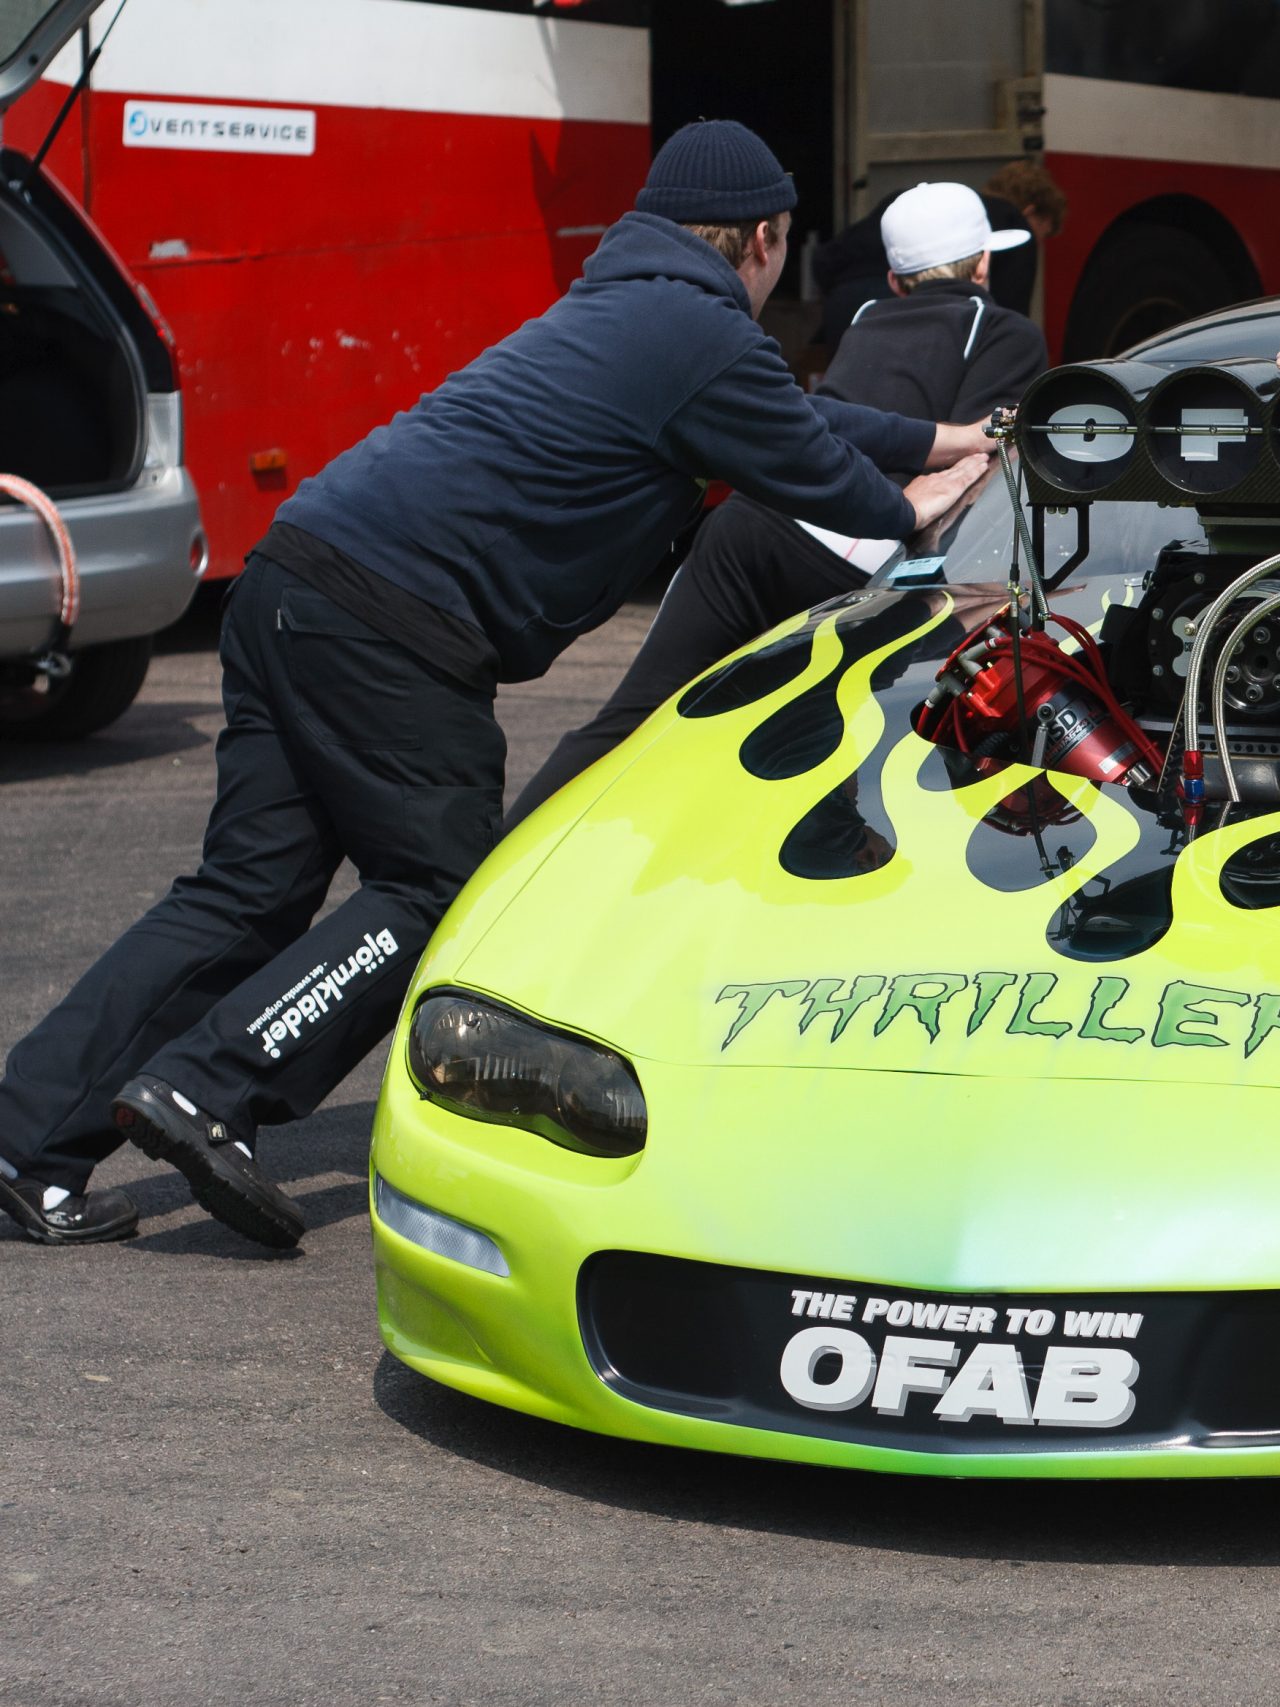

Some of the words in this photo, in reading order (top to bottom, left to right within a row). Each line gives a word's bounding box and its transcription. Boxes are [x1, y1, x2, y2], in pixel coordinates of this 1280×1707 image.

[151, 118, 307, 140] VENTSERVICE
[261, 928, 399, 1053] Björnkläder
[791, 1290, 857, 1322] THE
[861, 1297, 998, 1334] POWER
[1005, 1308, 1056, 1337] TO
[1063, 1310, 1143, 1339] WIN
[780, 1326, 1140, 1429] OFAB
